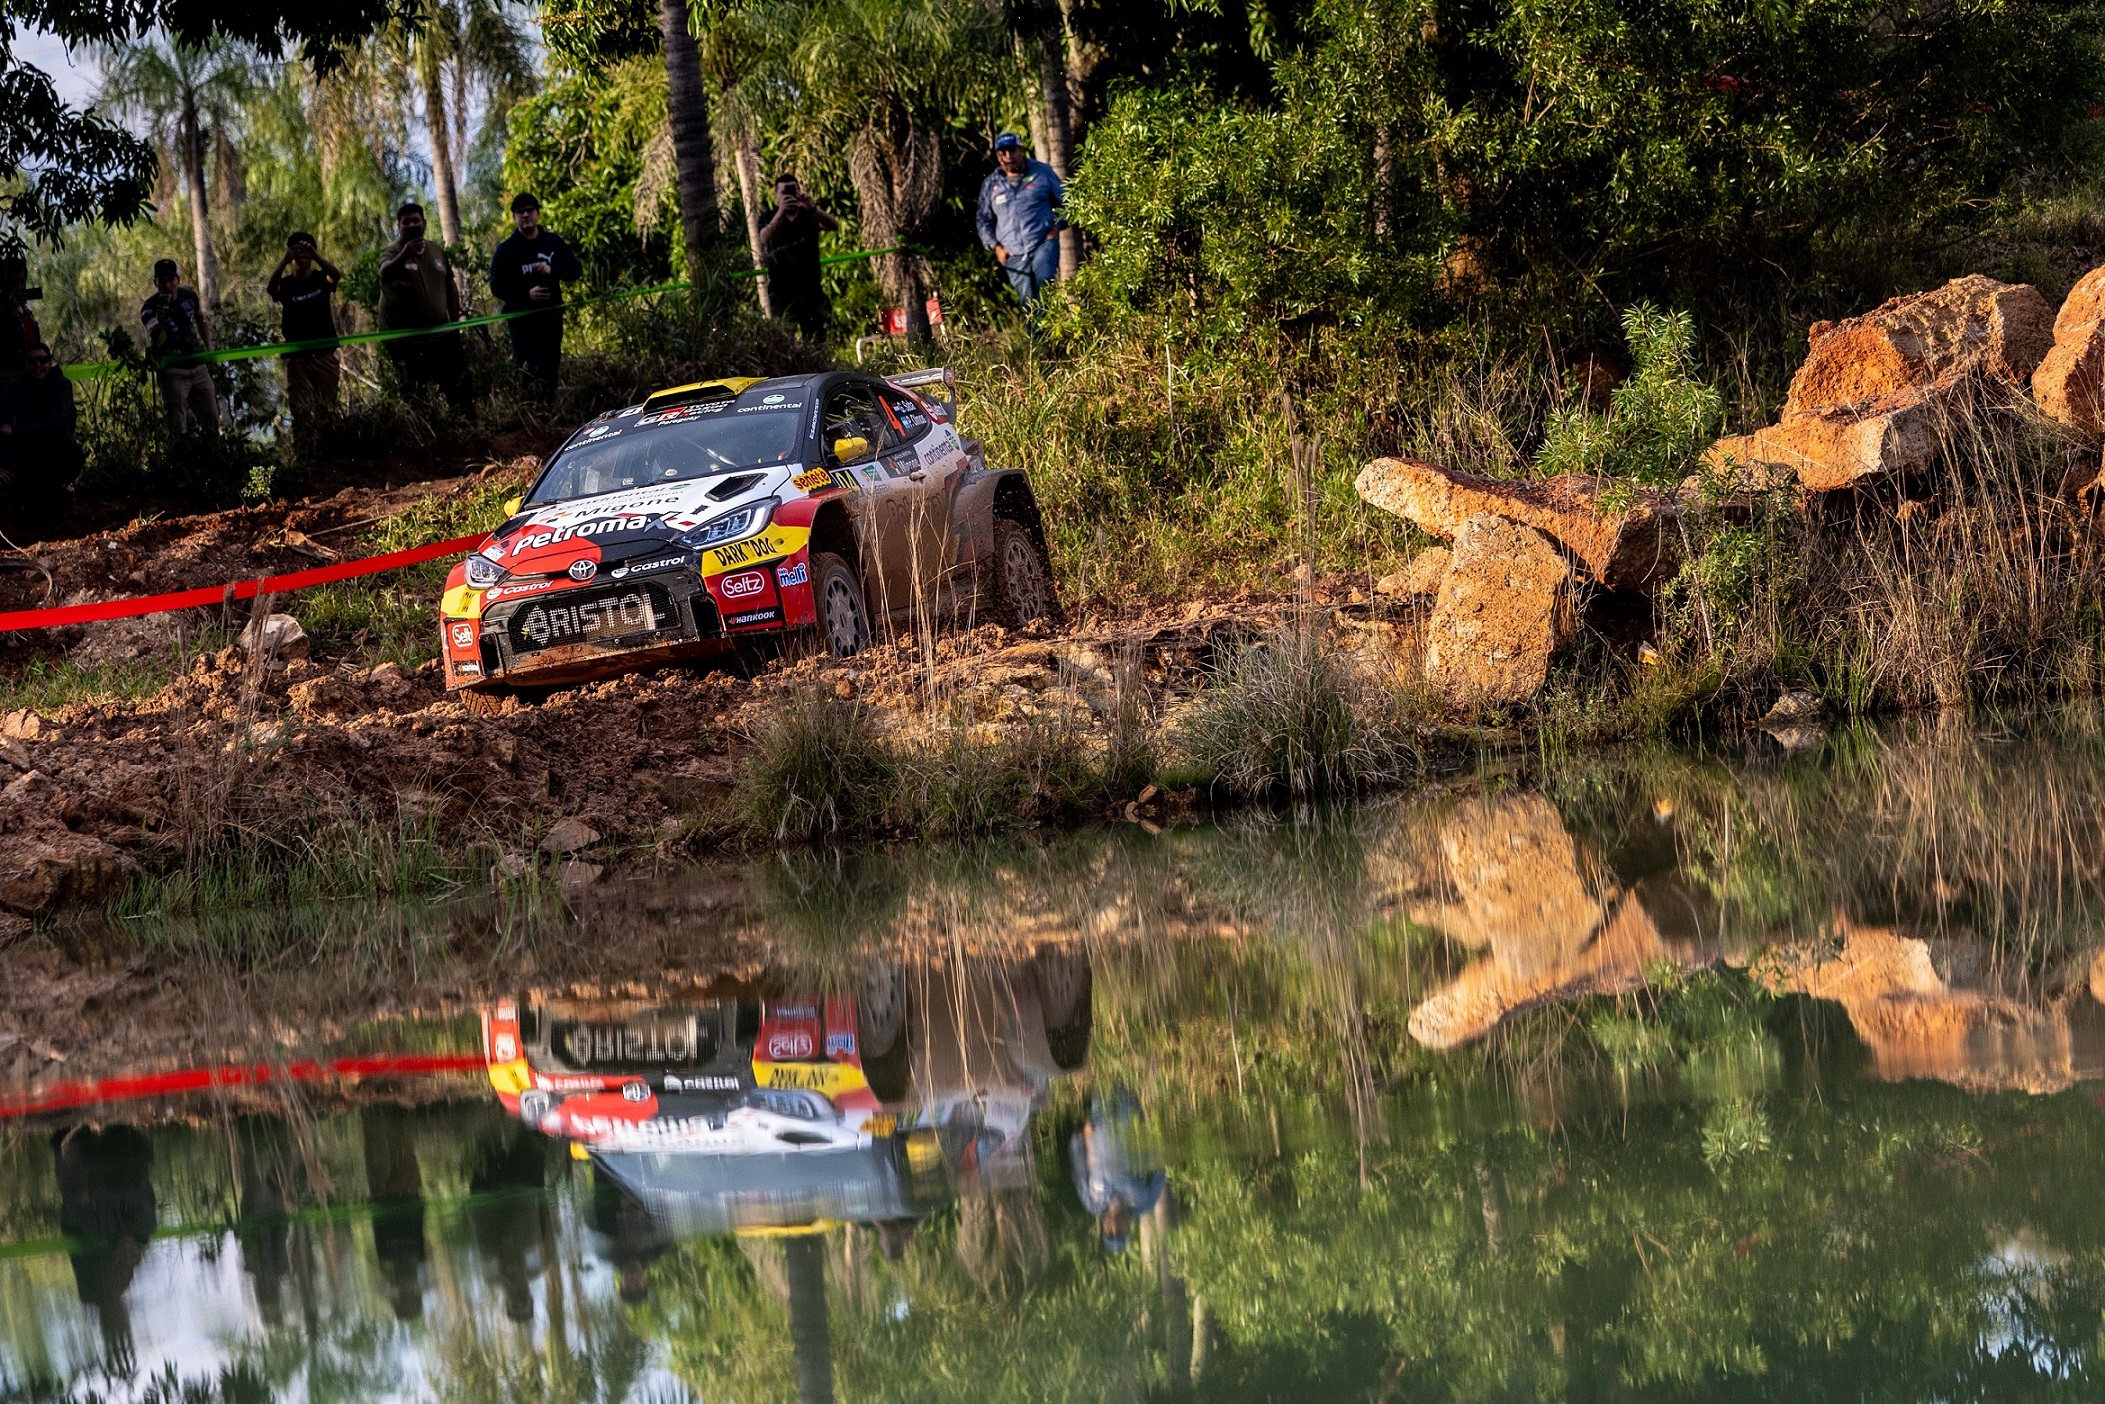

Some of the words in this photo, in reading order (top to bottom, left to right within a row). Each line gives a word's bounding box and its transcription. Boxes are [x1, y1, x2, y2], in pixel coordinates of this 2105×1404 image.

[635, 405, 688, 428] GR
[737, 402, 802, 413] continental
[878, 395, 906, 437] 4
[564, 429, 623, 452] continental
[792, 470, 830, 490] senete
[574, 496, 679, 518] Migone
[713, 543, 749, 567] DARK
[749, 537, 778, 558] DOG
[630, 555, 686, 573] Castrol
[779, 563, 807, 587] melli
[503, 581, 554, 596] Castrol
[725, 576, 761, 595] Seltz
